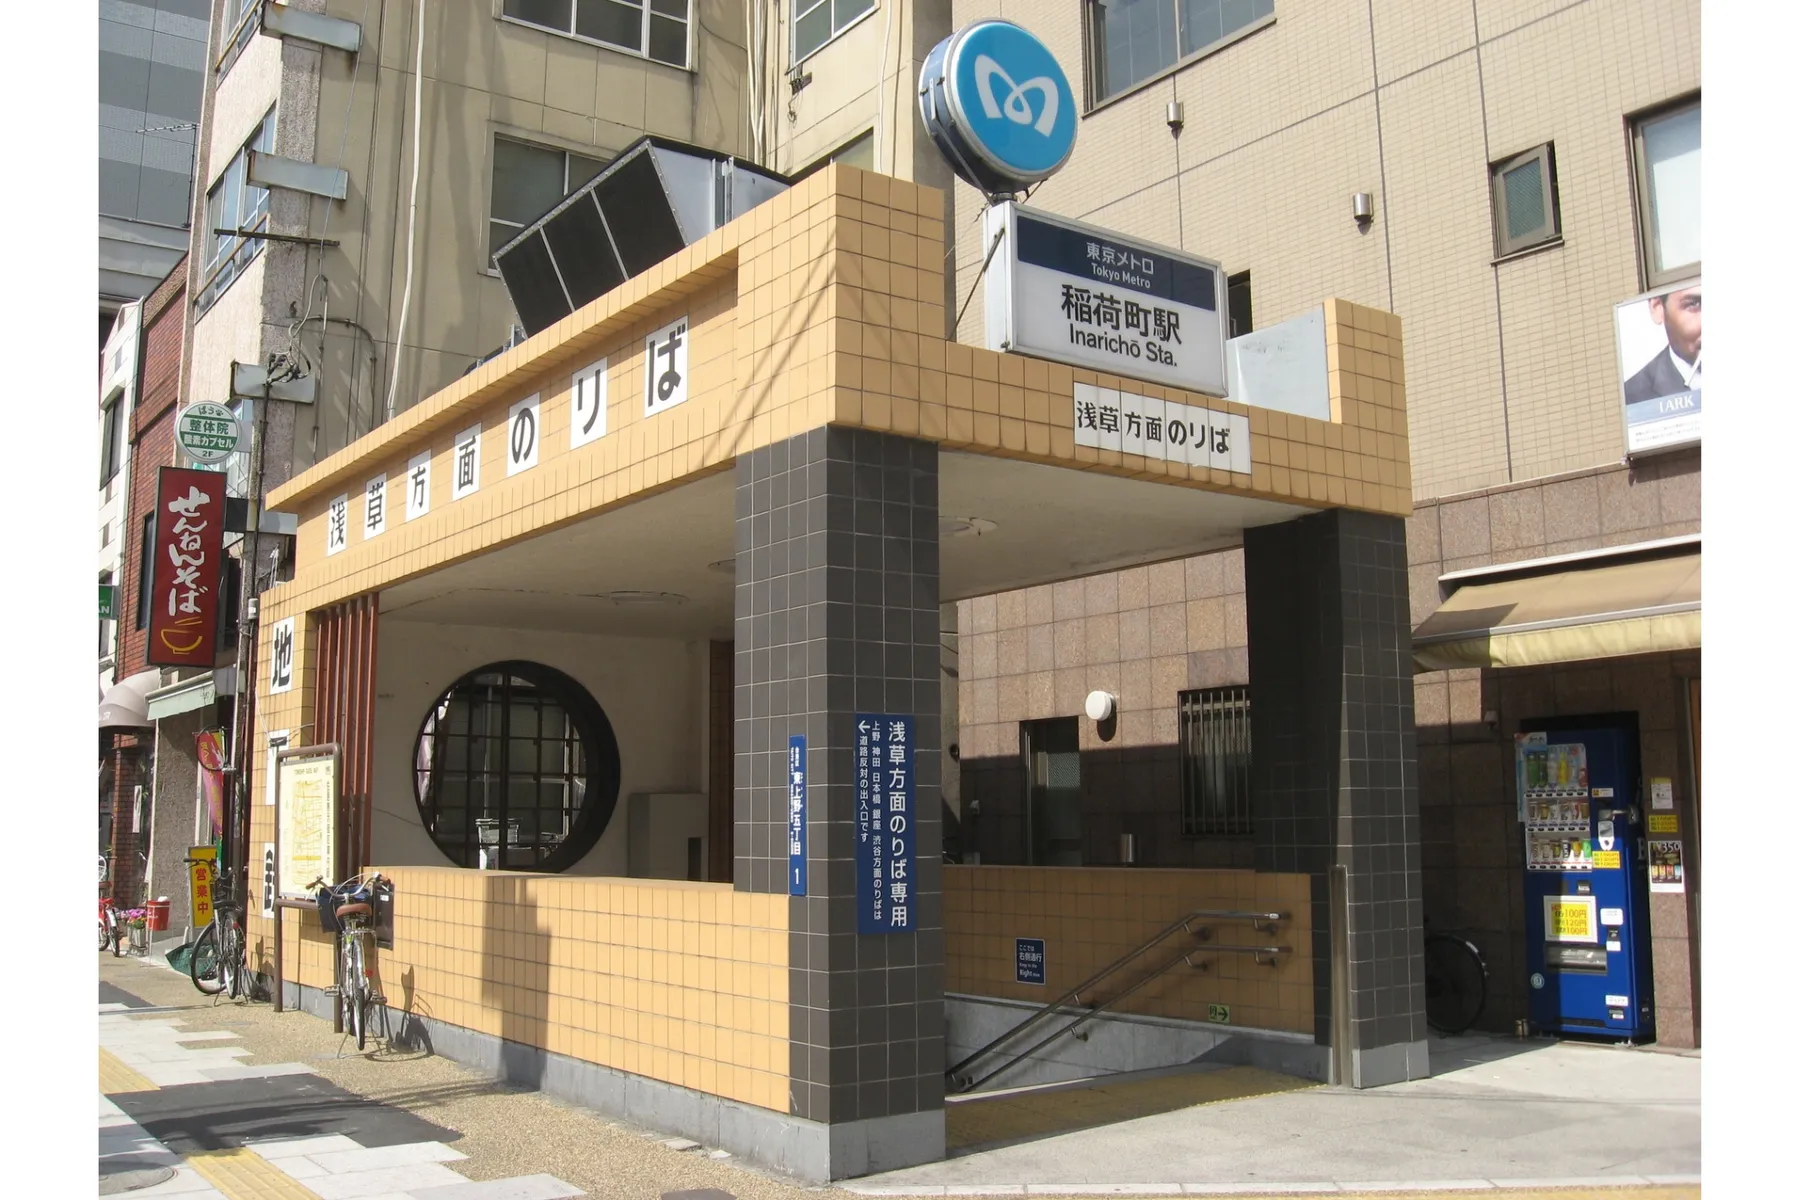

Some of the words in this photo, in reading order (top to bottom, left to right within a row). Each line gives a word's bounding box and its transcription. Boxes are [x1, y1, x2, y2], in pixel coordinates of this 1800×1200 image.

[1086, 242, 1154, 275] 東京メトロ
[1091, 262, 1120, 282] Tokyo
[1122, 270, 1151, 289] Metro
[1061, 284, 1182, 345] 稲荷町駅
[1070, 324, 1141, 358] Inarichō
[1146, 341, 1178, 367] Sta.
[189, 419, 229, 435] 整体院
[330, 322, 687, 549] 浅草方面のりば
[1076, 400, 1231, 454] 浅草方面のりば
[202, 450, 214, 458] 2F
[168, 486, 211, 617] せんねんそば
[872, 721, 881, 741] 上野
[872, 747, 881, 767] 神田
[859, 736, 868, 842] 道路反対の出入口です
[872, 772, 881, 804] 日本橋
[872, 809, 881, 830] 銀座
[888, 721, 908, 928] 浅草方面のりば専用
[196, 867, 209, 915] 営業中
[794, 867, 800, 885] 1
[873, 836, 883, 920] 渋谷方面のりばは
